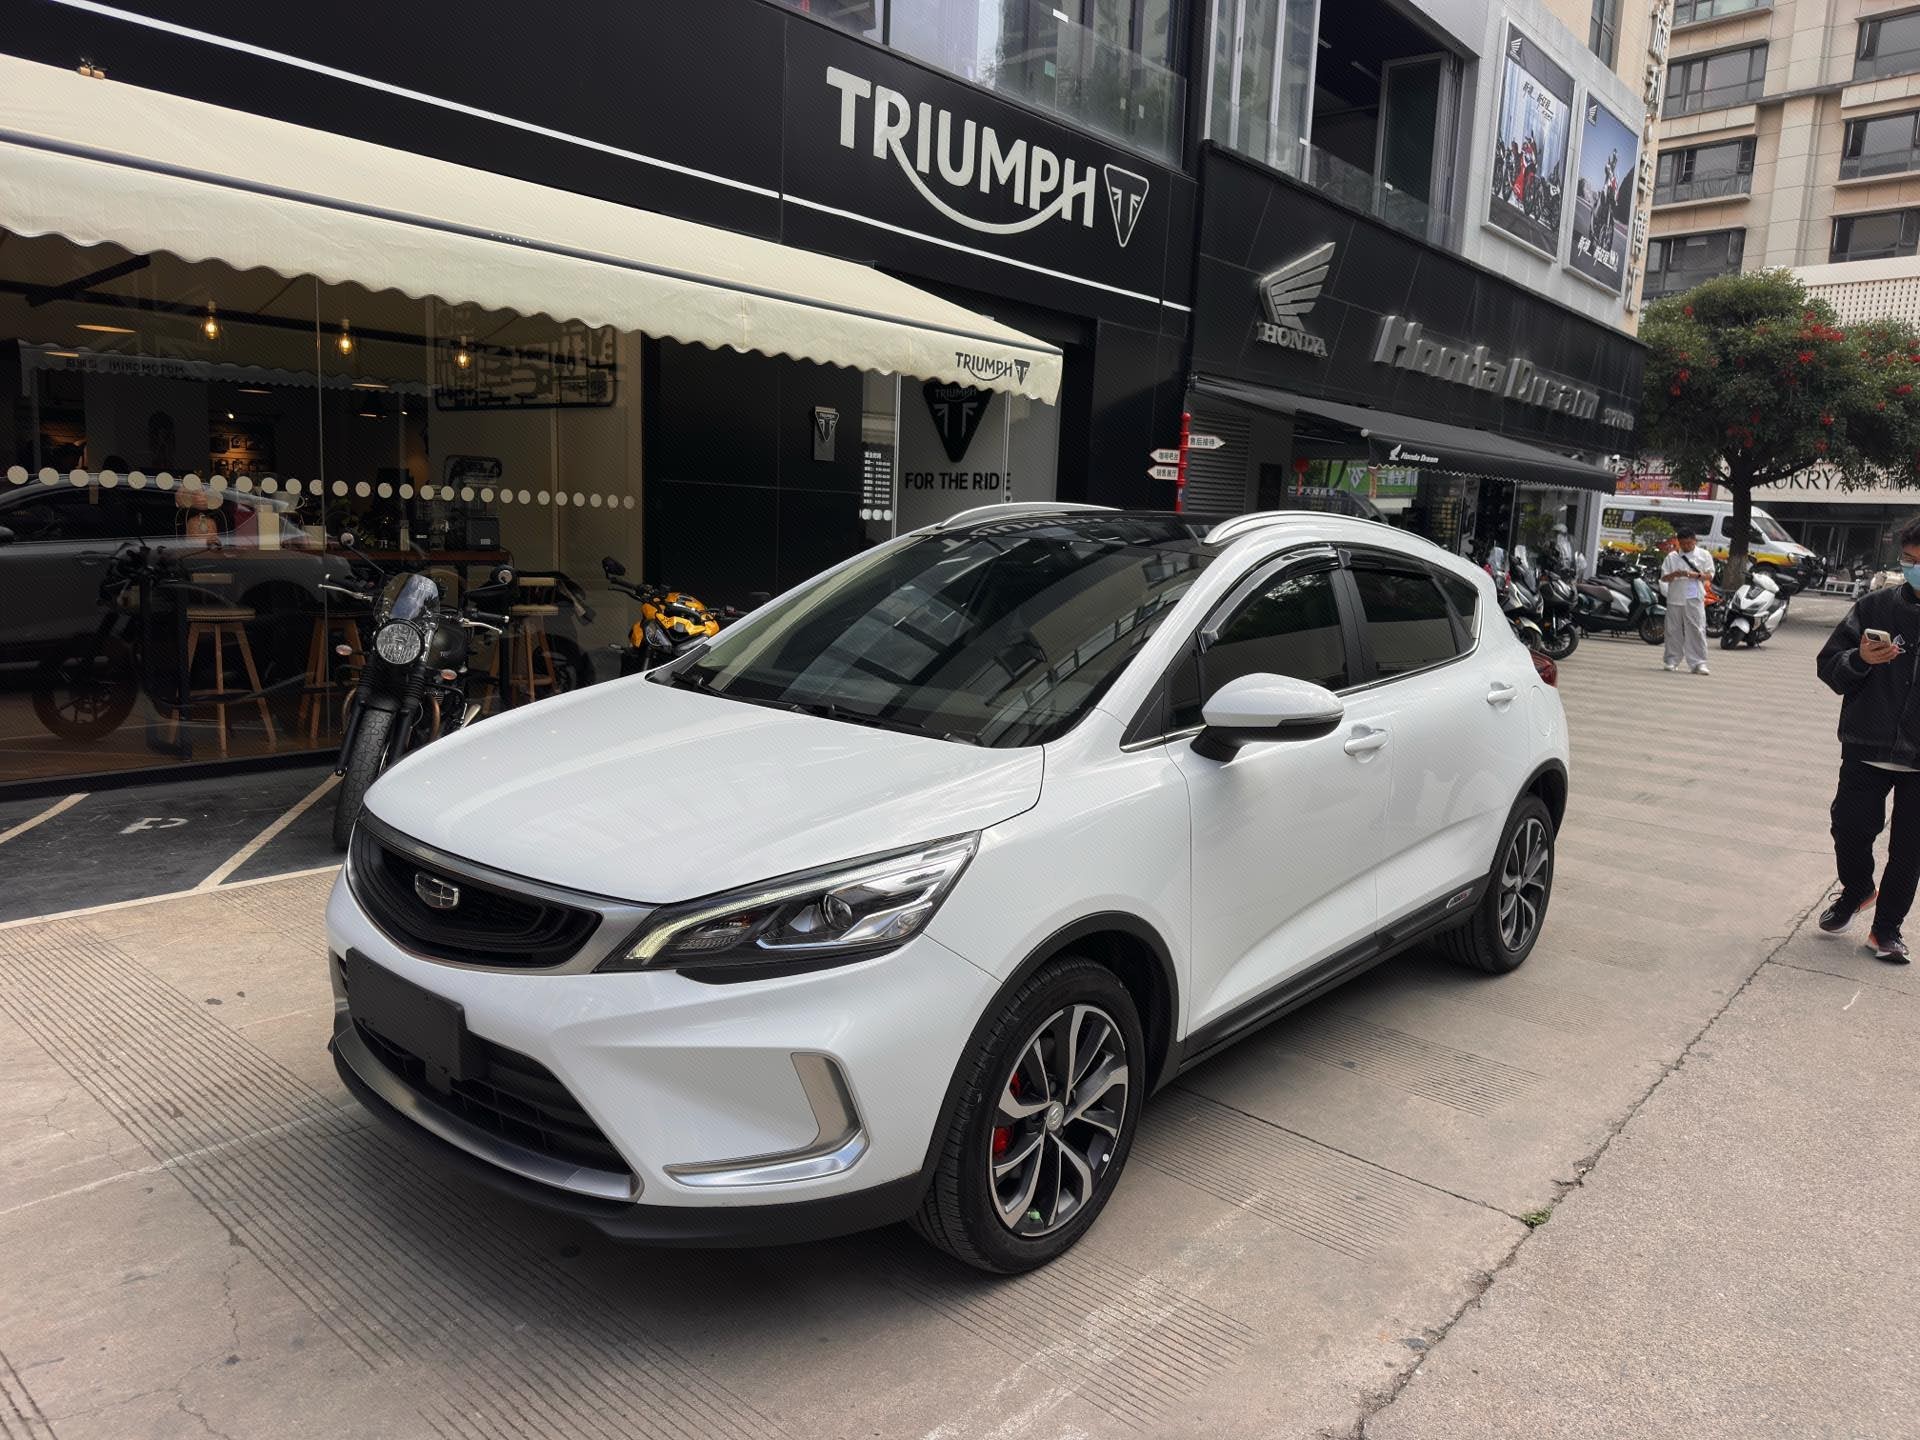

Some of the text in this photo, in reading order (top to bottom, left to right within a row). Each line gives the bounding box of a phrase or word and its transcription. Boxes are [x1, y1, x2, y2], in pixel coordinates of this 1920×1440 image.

[826, 66, 1096, 234] TRIUMPH
[1256, 321, 1328, 357] HONDA
[955, 352, 1012, 381] TRIUMPH
[1373, 315, 1506, 393] Honda
[1503, 358, 1600, 419] Dream
[935, 387, 977, 401] TRIUMPH
[1400, 452, 1439, 464] Honda Dream
[904, 472, 1011, 490] FOR THE RIDE
